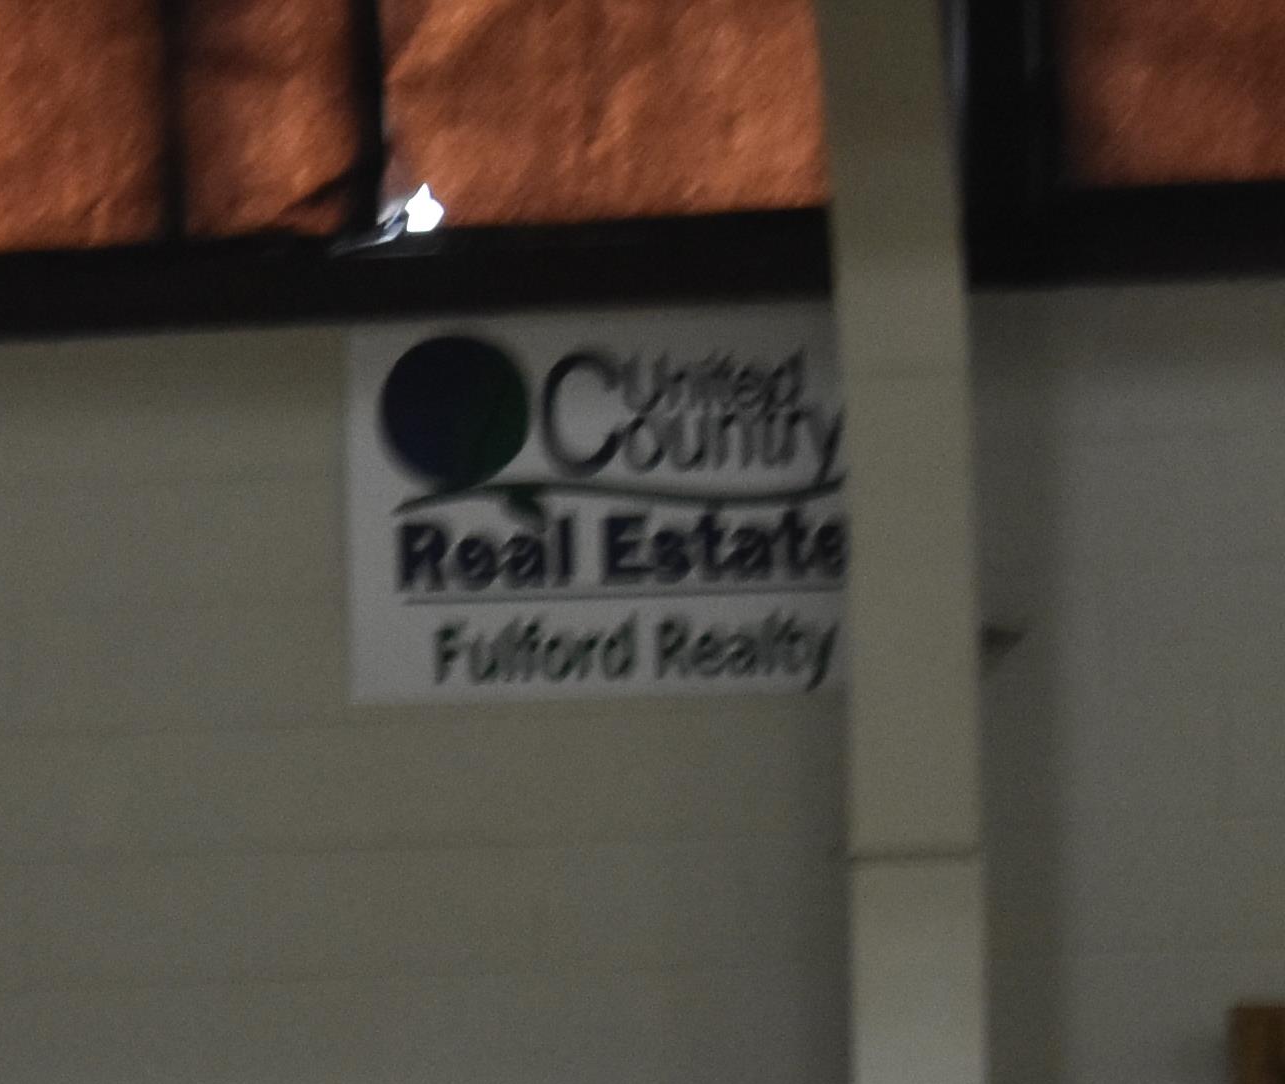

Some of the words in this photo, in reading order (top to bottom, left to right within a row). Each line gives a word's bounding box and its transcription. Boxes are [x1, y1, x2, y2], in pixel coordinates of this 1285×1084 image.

[541, 350, 845, 488] Country
[625, 346, 807, 410] United
[395, 510, 577, 592] Real
[601, 503, 847, 586] Estate
[653, 608, 839, 692] Realty
